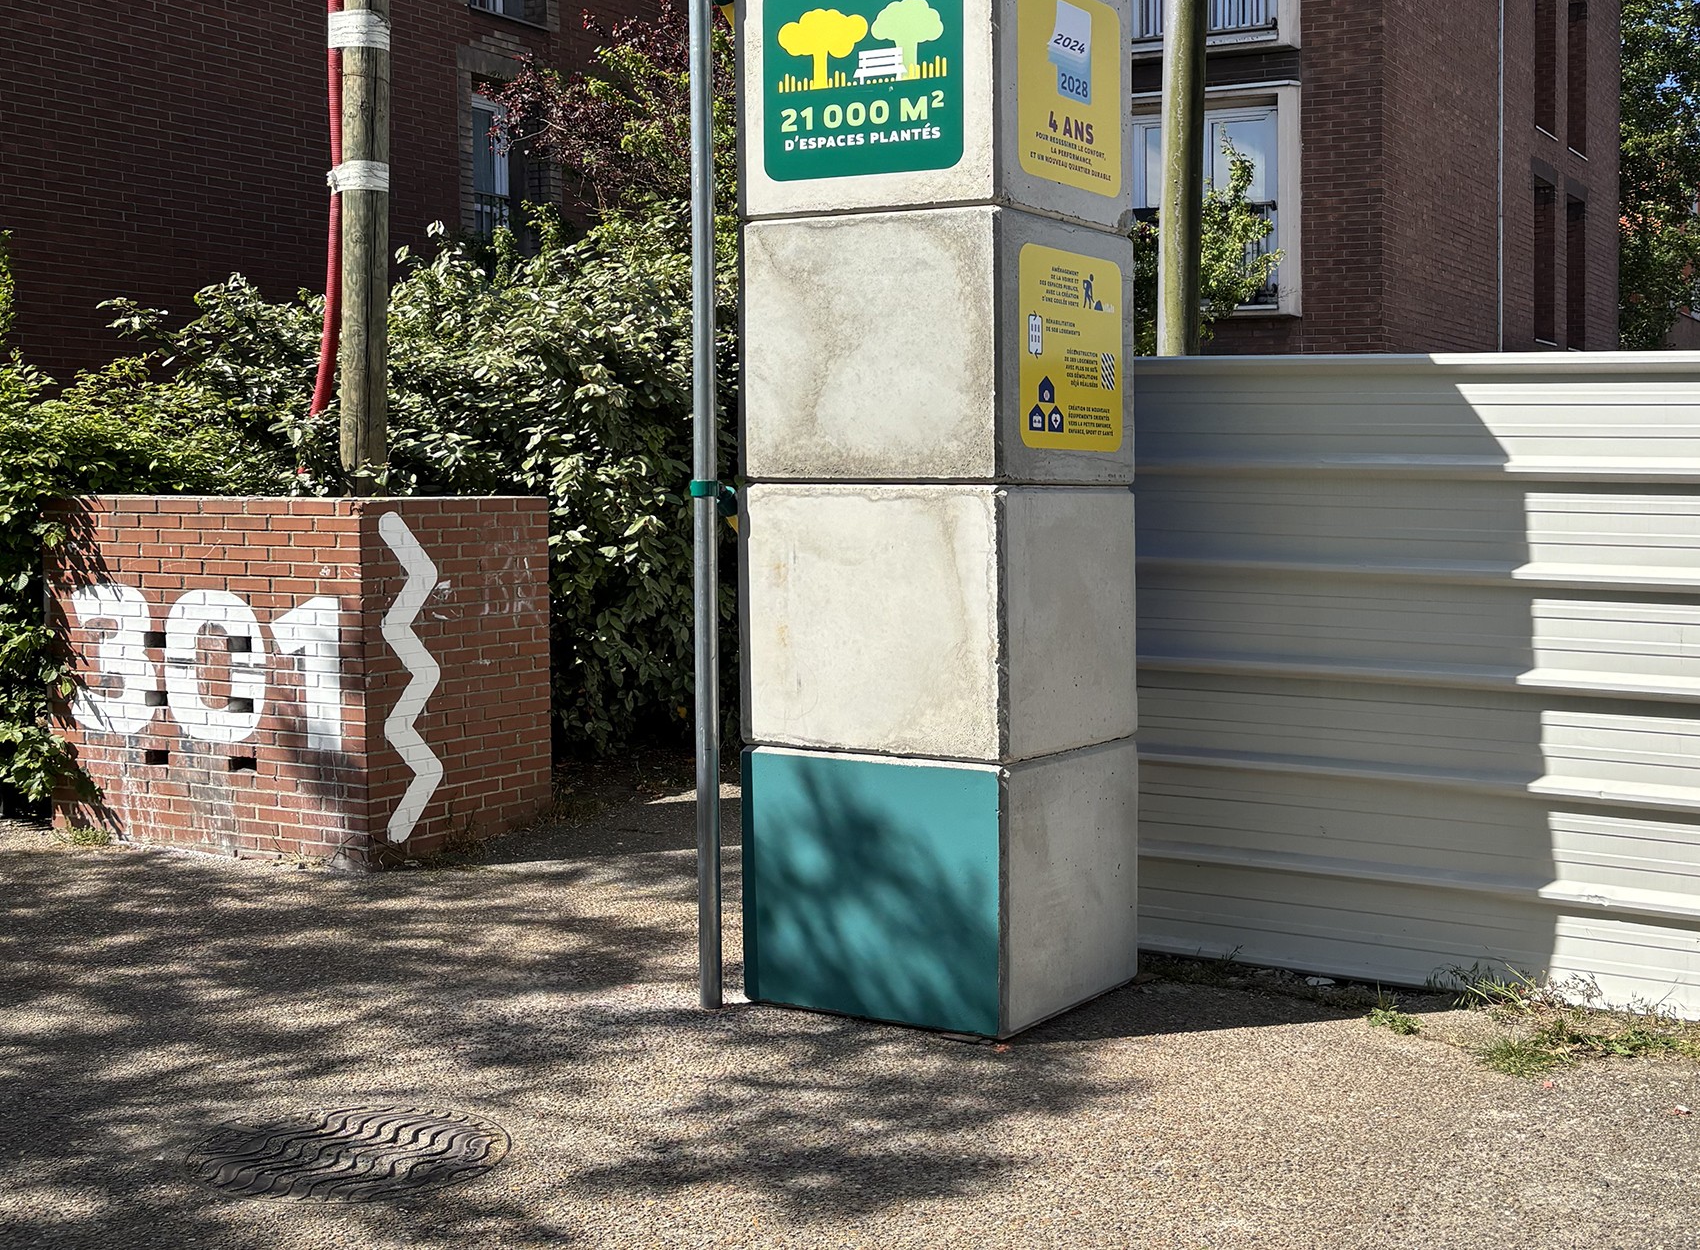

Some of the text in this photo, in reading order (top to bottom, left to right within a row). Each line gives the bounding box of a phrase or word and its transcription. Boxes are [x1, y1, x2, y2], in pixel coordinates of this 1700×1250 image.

[1054, 34, 1085, 54] 2024
[1061, 73, 1088, 98] 2028
[780, 106, 813, 132] 21
[823, 100, 890, 128] 000
[1048, 110, 1094, 144] 4 ANS
[870, 123, 941, 144] PLANTÉS
[1036, 132, 1048, 140] POUR
[71, 583, 343, 750] 301
